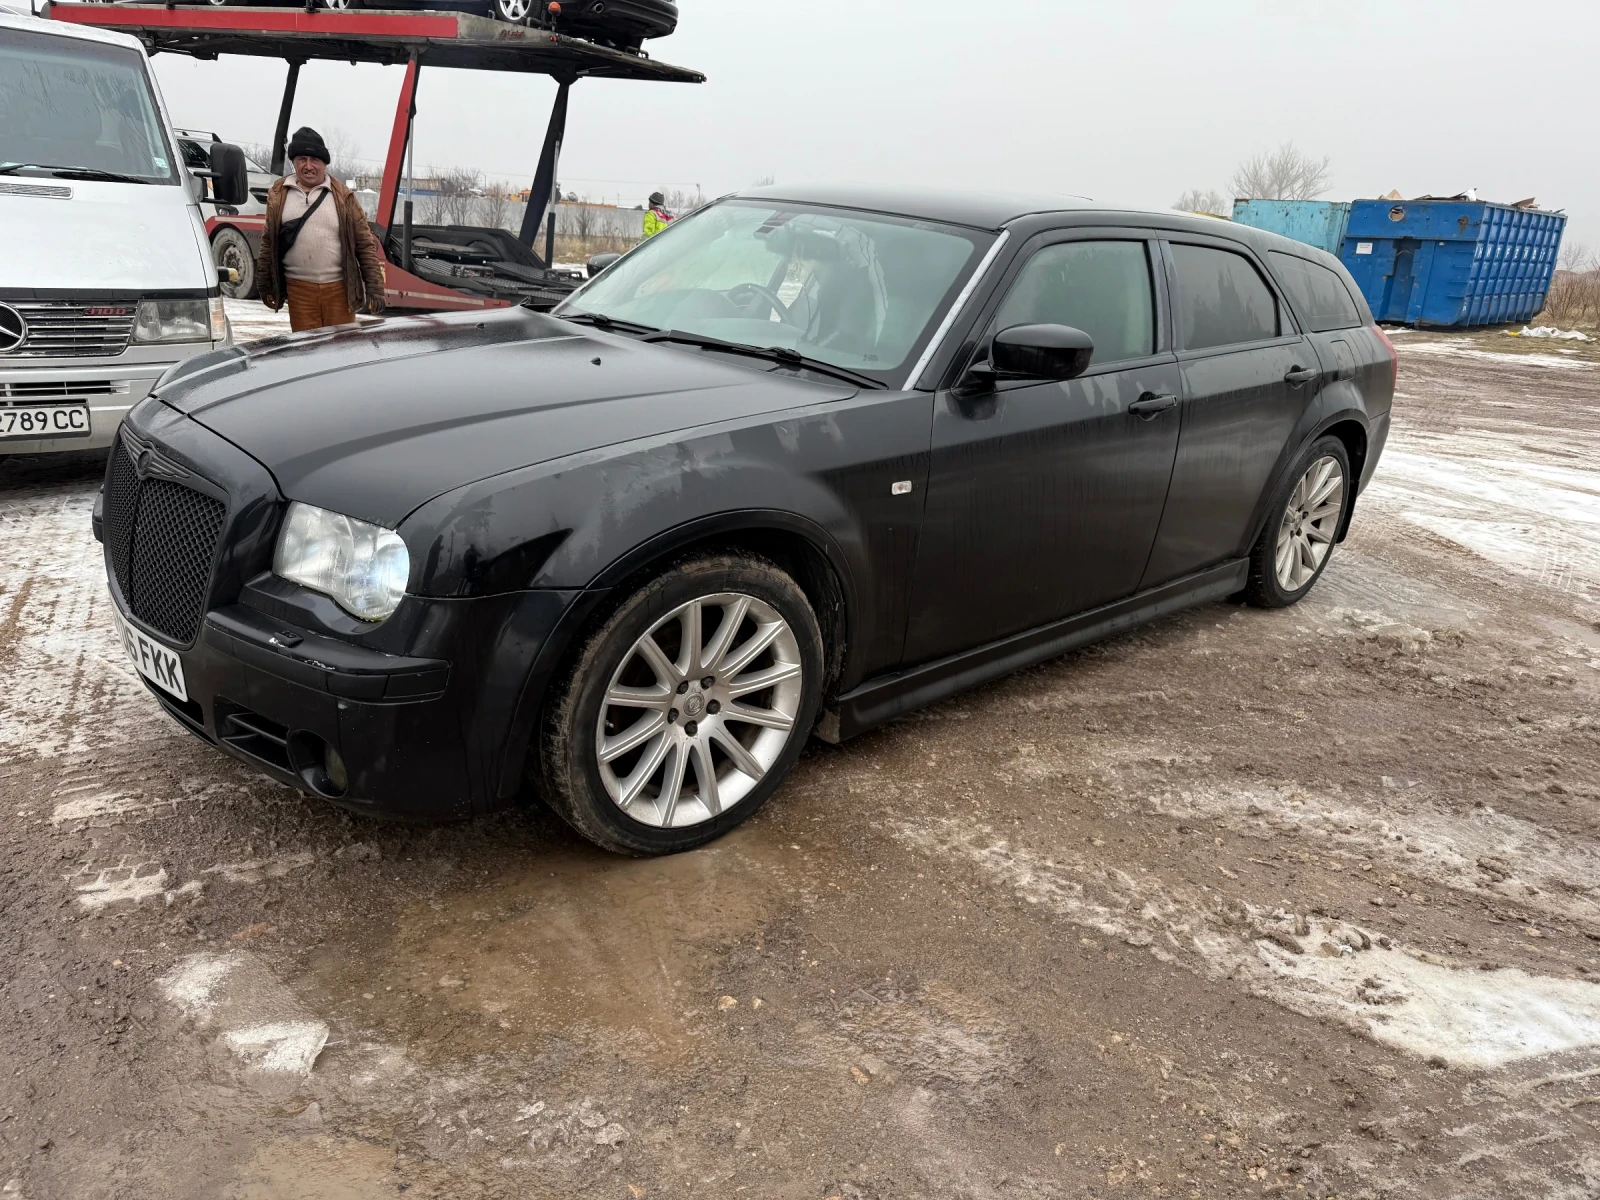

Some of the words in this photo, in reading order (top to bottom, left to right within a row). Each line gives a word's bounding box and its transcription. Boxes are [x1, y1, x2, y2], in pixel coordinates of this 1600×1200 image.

[0, 411, 48, 432] 789
[53, 409, 84, 429] CC
[137, 635, 184, 694] FKK
